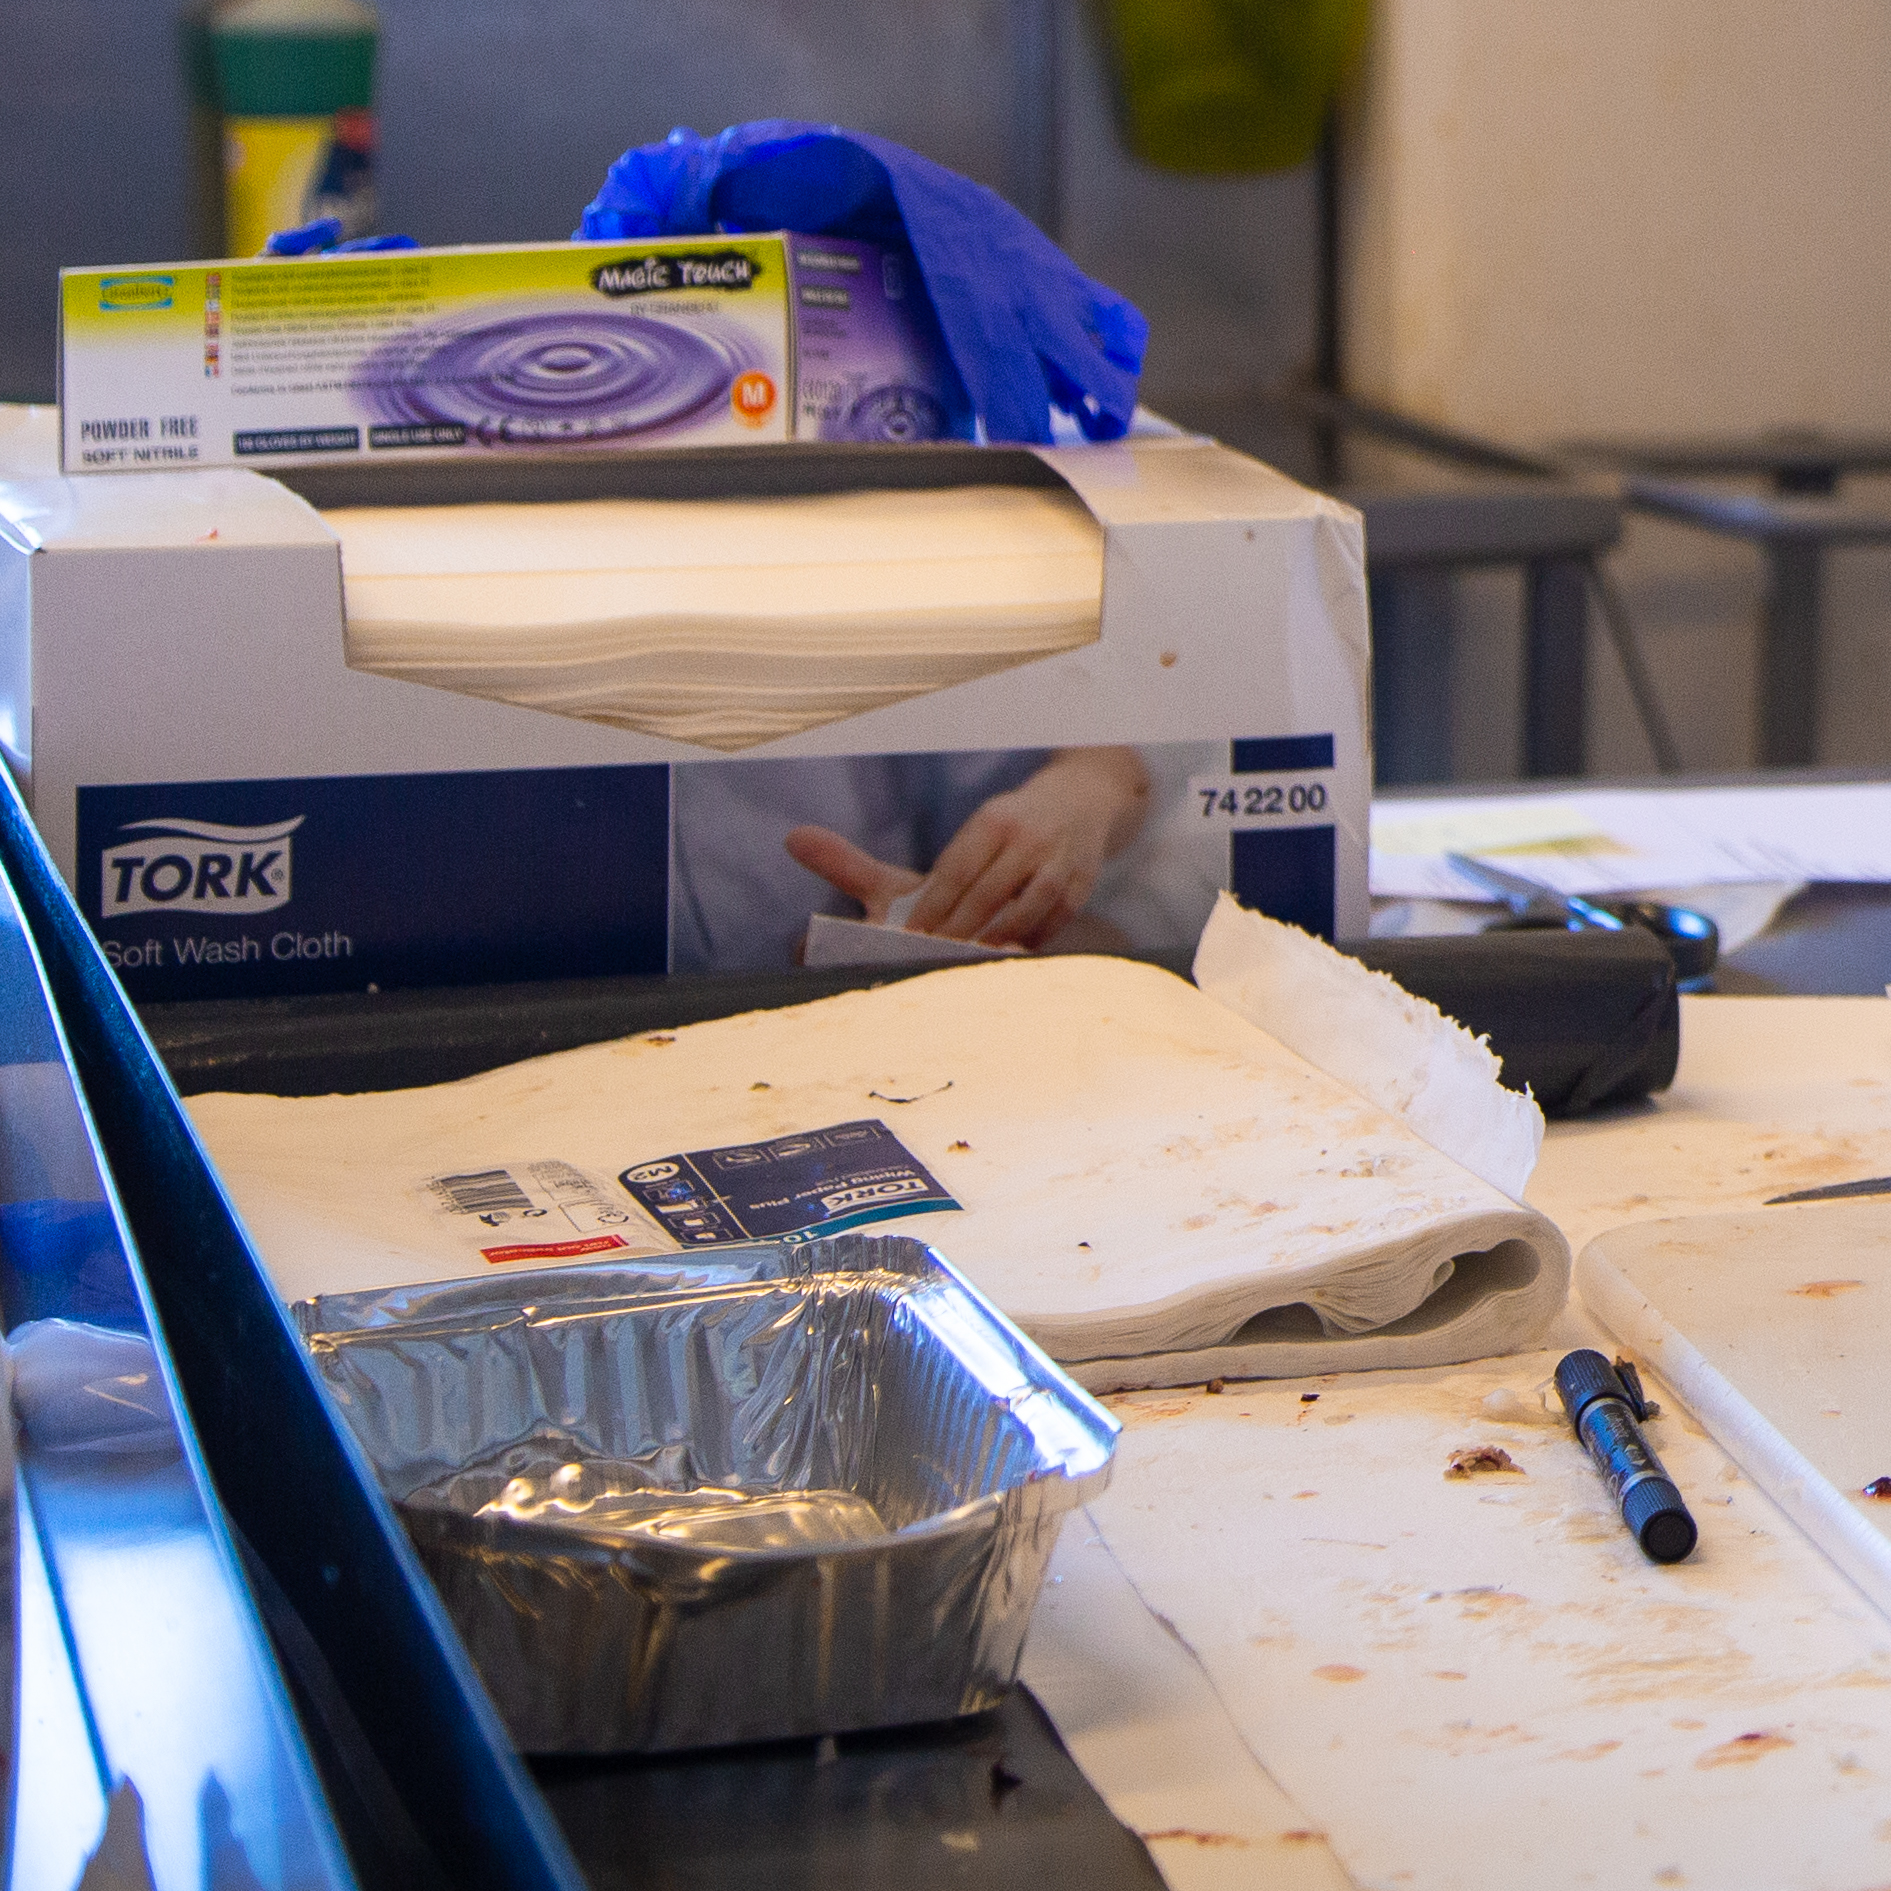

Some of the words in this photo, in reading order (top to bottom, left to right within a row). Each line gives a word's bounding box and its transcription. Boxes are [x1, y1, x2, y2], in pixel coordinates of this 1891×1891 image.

[677, 258, 750, 285] TOUCH
[80, 417, 150, 441] POWDER
[160, 415, 198, 437] FREE
[133, 444, 198, 462] NITRILE
[111, 850, 283, 903] TORK
[102, 938, 163, 968] Soft
[173, 935, 260, 964] Wash
[271, 930, 352, 960] Cloth
[749, 1196, 790, 1209] Plus
[828, 1181, 923, 1206] TORK
